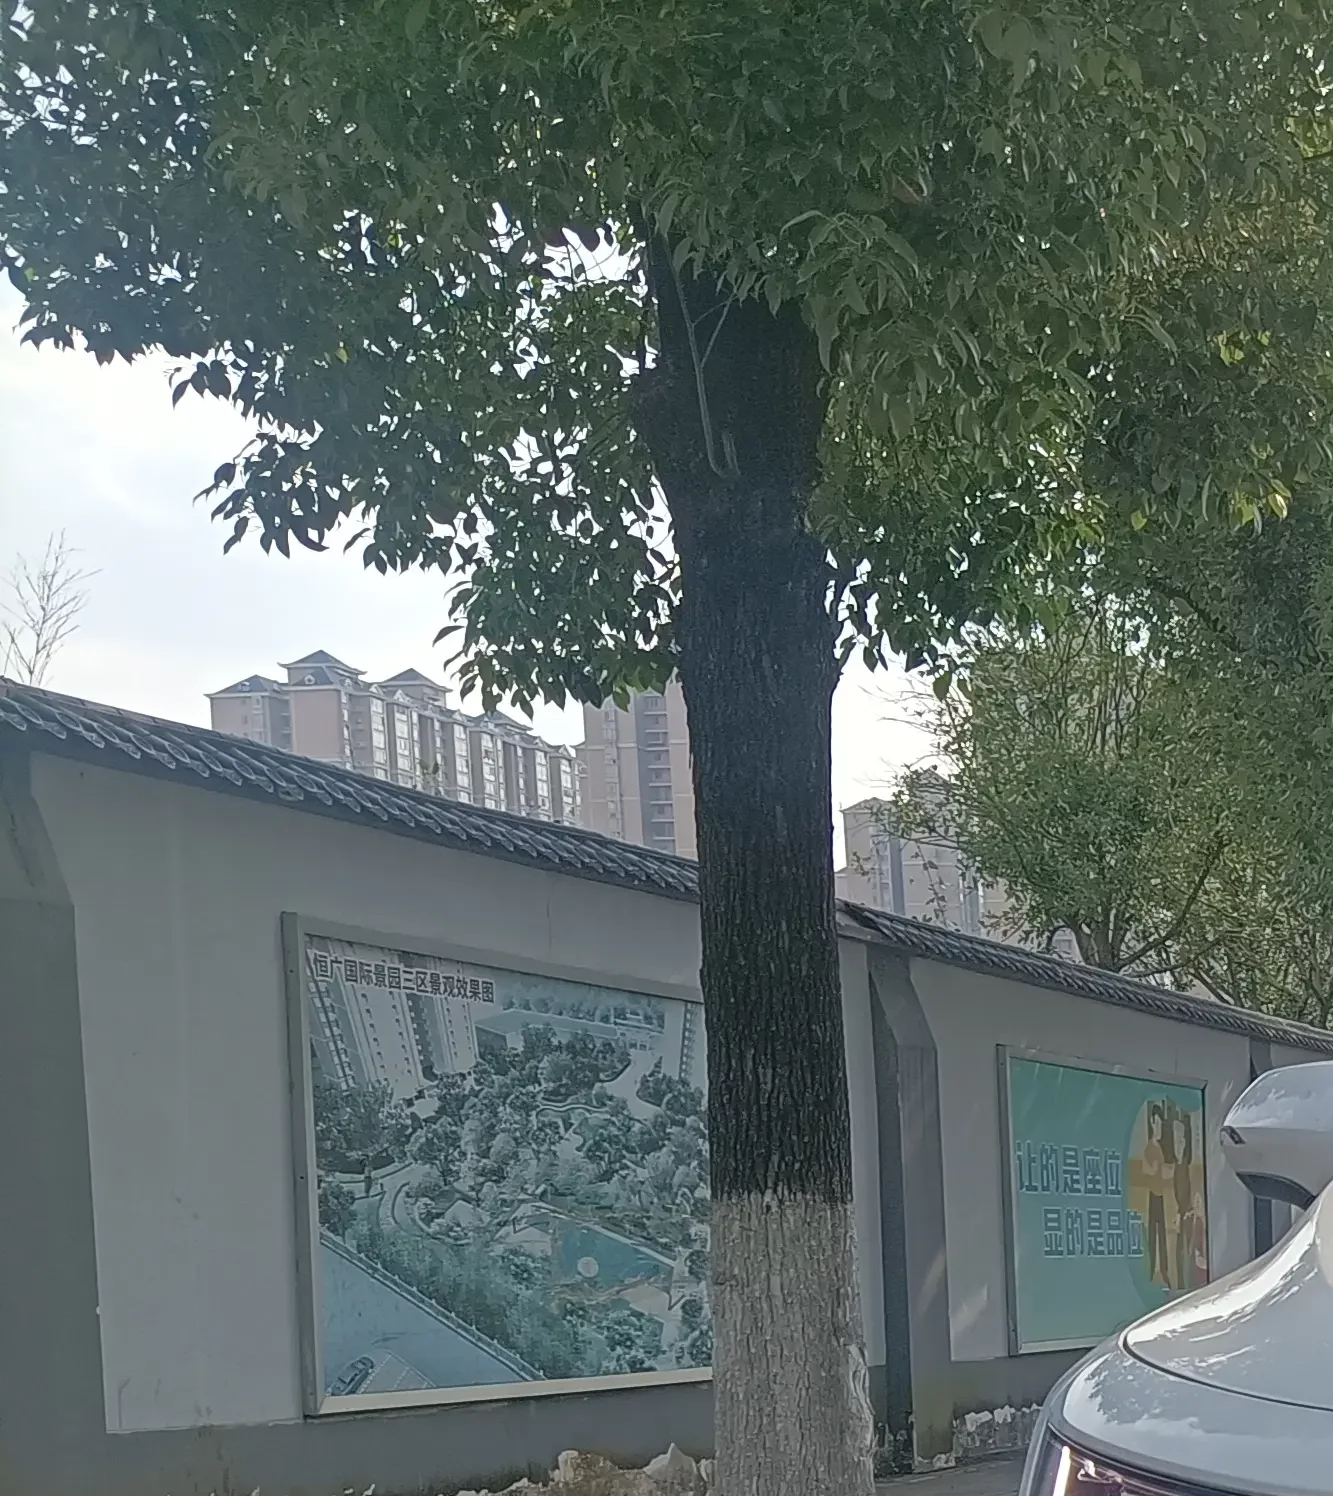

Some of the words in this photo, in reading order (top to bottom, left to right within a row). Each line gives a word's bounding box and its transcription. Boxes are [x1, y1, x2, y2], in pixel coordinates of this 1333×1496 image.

[313, 952, 495, 1003] 恒广国际景园三区景观效果图
[1015, 1140, 1122, 1197] 让的是座位
[1043, 1206, 1145, 1258] 显的是品位
